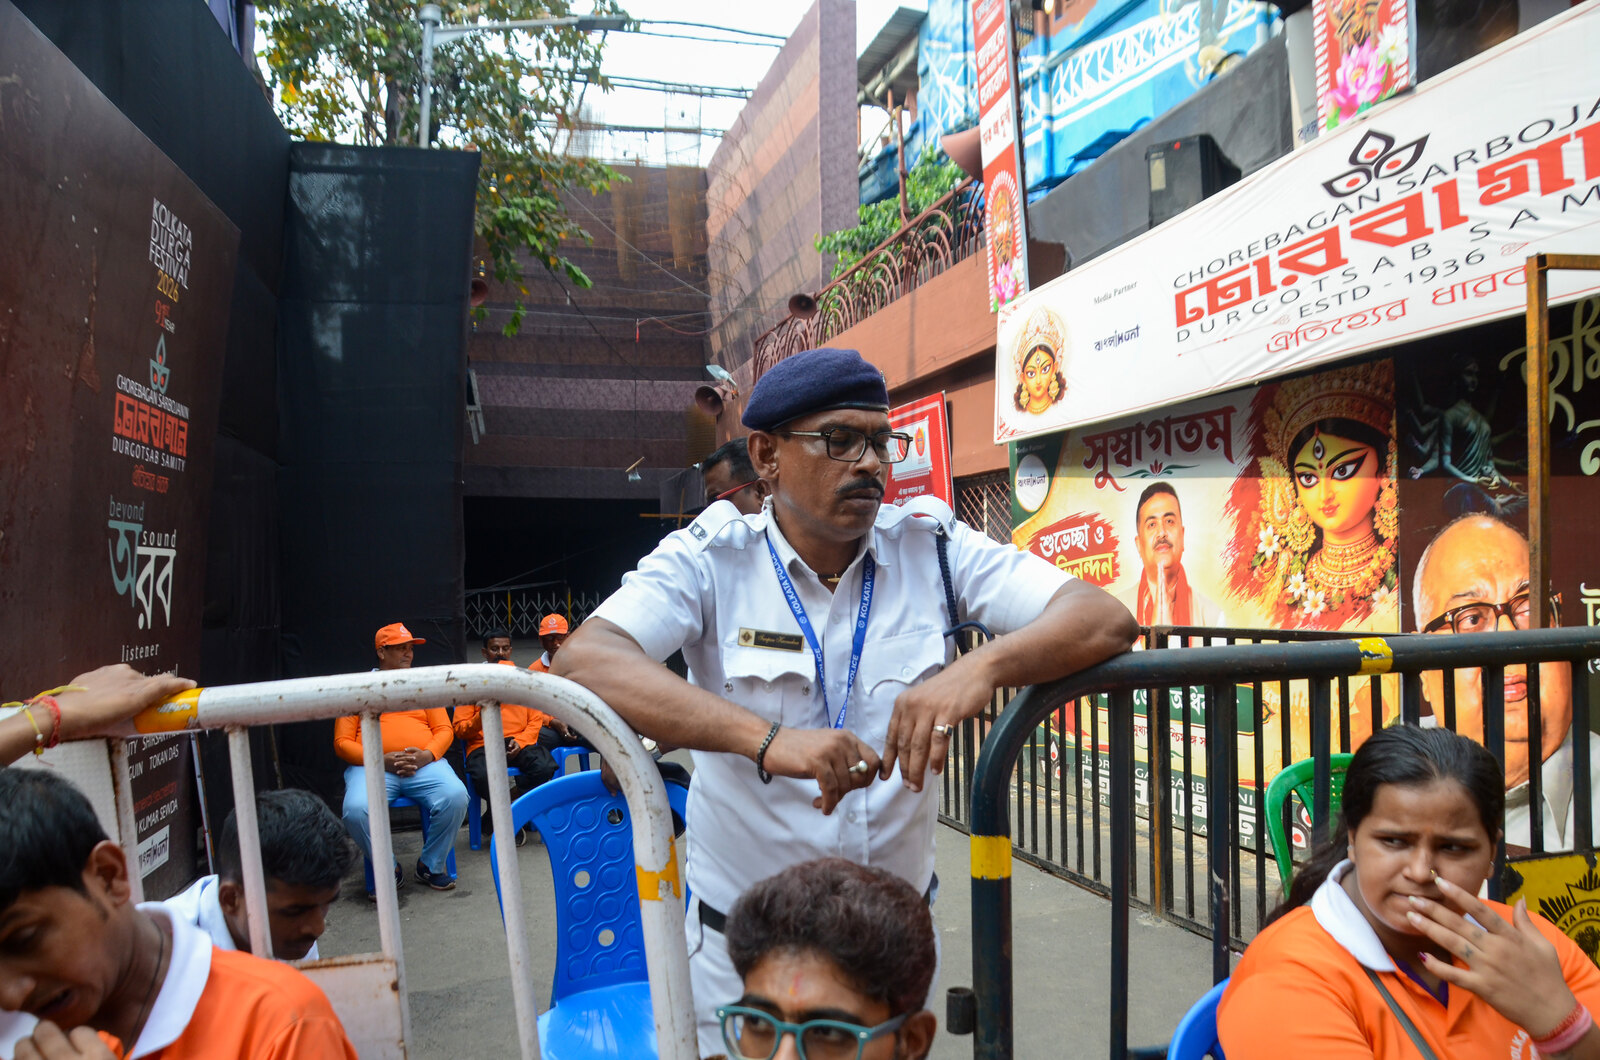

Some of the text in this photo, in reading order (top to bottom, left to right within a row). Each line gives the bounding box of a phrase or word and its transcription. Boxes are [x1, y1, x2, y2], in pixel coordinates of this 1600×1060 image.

[152, 197, 192, 251] KOLKATA
[1173, 187, 1381, 289] CHOREBAGAN
[150, 219, 191, 270] DURGA
[148, 240, 189, 290] FESTIVAL
[1299, 285, 1371, 318] ESTD
[1404, 248, 1486, 285] 1936
[156, 269, 179, 303] 2026
[1094, 280, 1138, 305] Media Partner
[1176, 242, 1432, 343] DURGOTSAB
[116, 373, 158, 406] CHOREBAGAN
[113, 391, 188, 458] চোরবাগান
[112, 436, 186, 473] DURGOTSAB SAMITY
[1081, 405, 1238, 492] সুস্বাগতম
[109, 494, 144, 521] beyond
[142, 529, 177, 548] sound
[1039, 522, 1105, 558] শুভেচ্ছা ও
[1055, 552, 1115, 581] ভিনন্দন
[781, 577, 802, 615] KOLKATA
[860, 556, 874, 619] KOLKATA POLIC
[121, 643, 160, 663] listener
[149, 748, 168, 770] TOKAN
[168, 743, 179, 762] DAS
[138, 810, 160, 835] KUMAR
